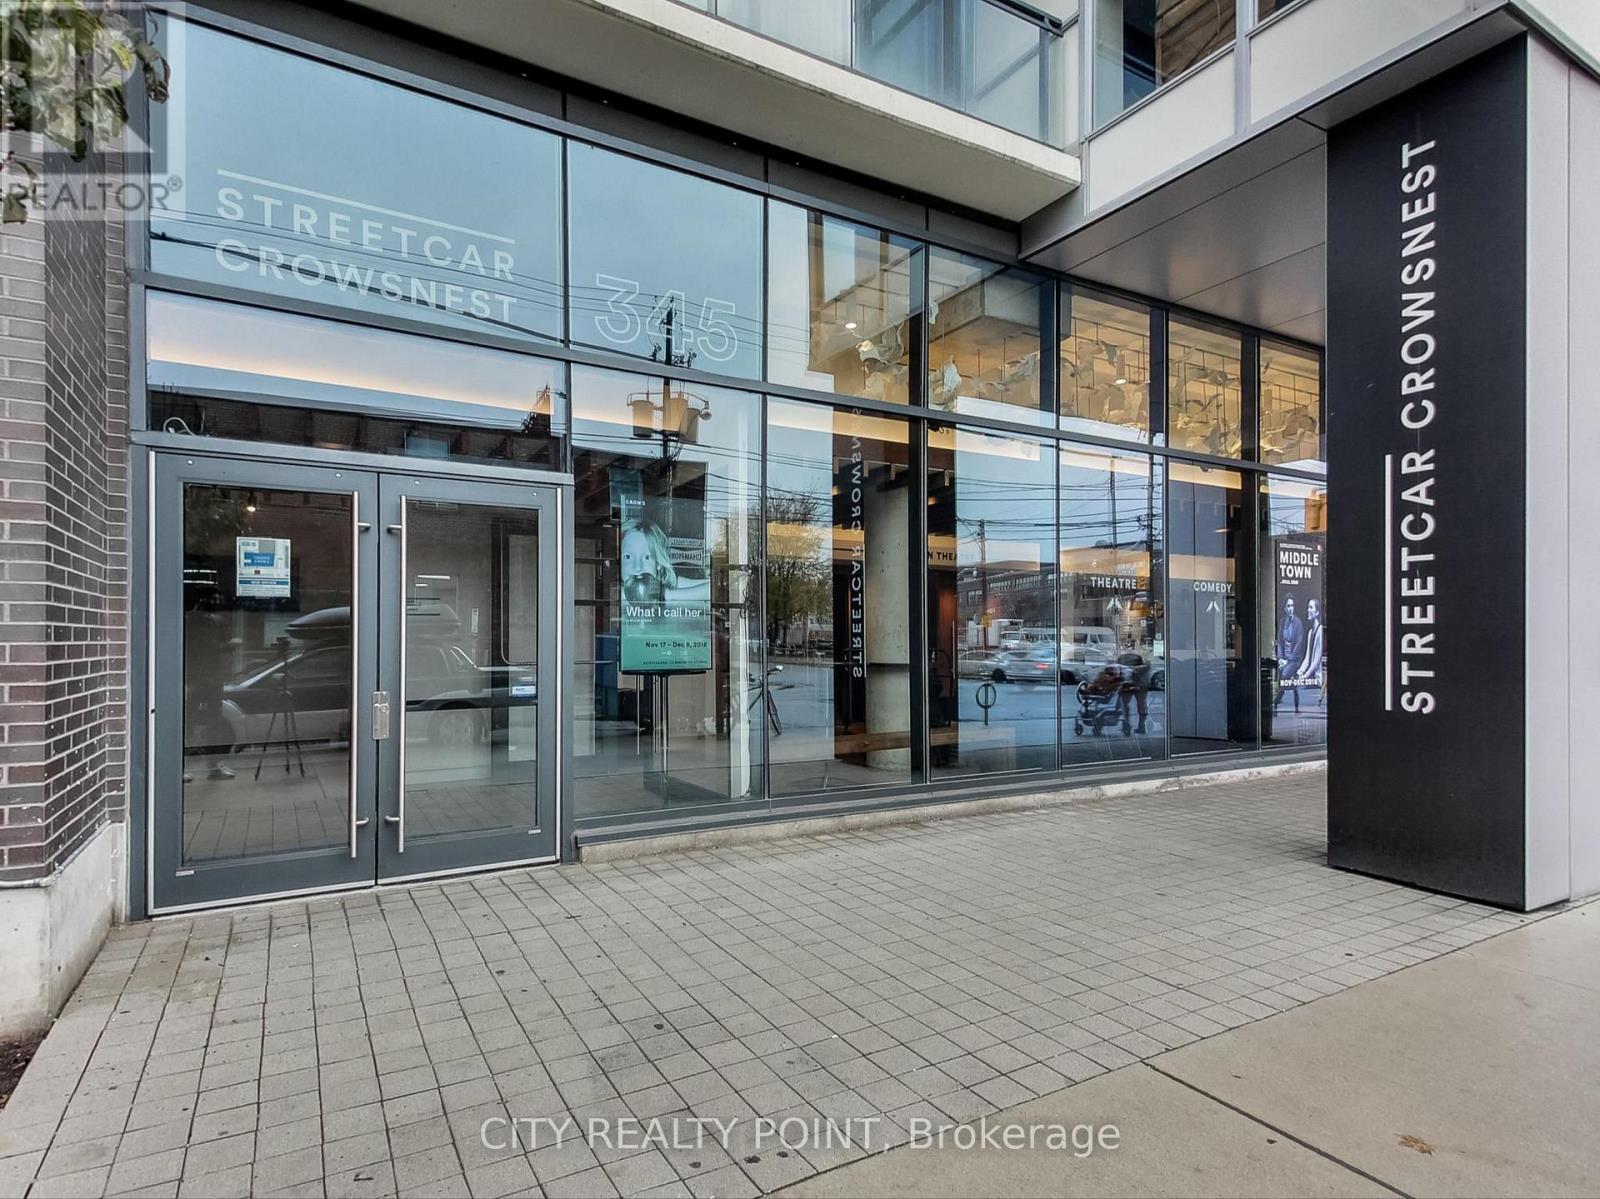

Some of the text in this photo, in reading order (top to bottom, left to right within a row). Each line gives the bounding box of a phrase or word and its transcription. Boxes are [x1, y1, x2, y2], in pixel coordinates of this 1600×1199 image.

[216, 187, 515, 281] STREETCAR
[215, 239, 517, 323] CROWSNEST
[594, 273, 738, 362] 345
[1401, 138, 1437, 714] STREETCAR CROWSNEST
[1280, 551, 1320, 566] MIDDLE
[1279, 564, 1312, 579] TOWN
[1090, 576, 1137, 590] THEATRE
[1193, 581, 1232, 593] COMEDY
[626, 606, 702, 618] What I call her
[645, 641, 658, 649] Nov
[672, 641, 685, 649] Dec
